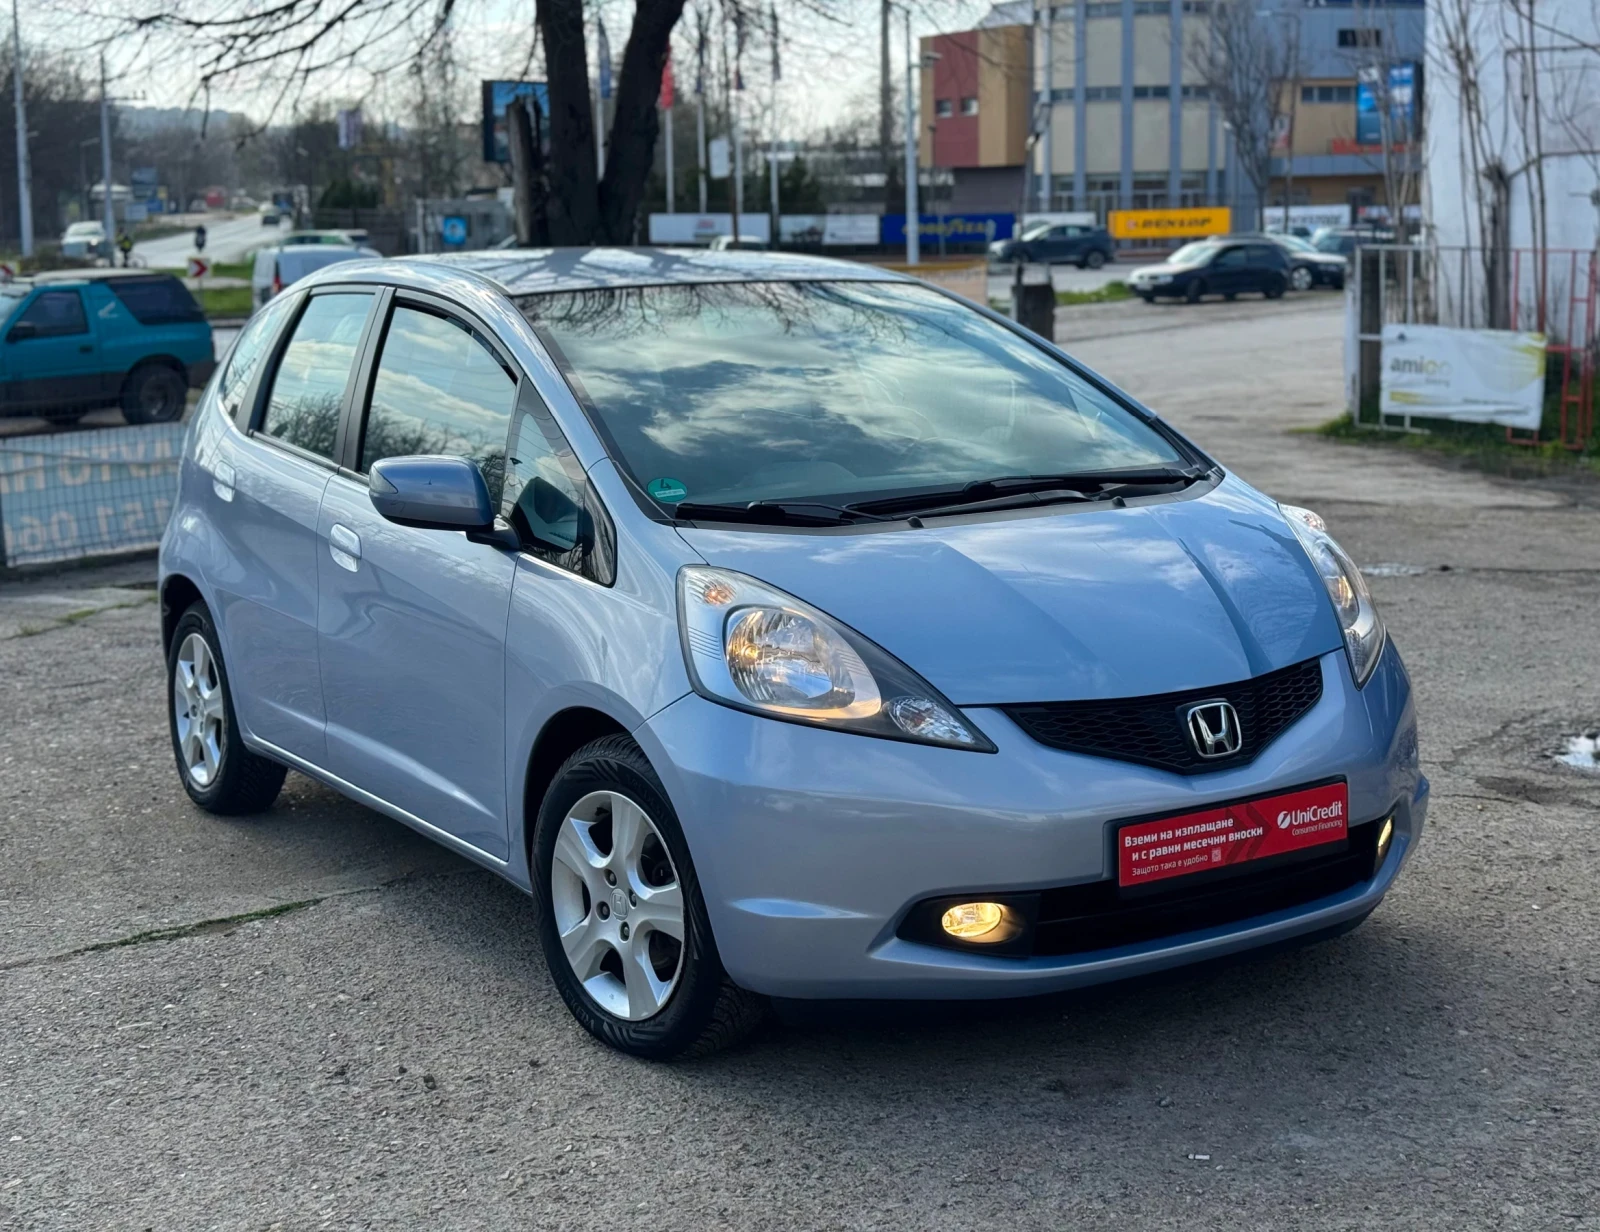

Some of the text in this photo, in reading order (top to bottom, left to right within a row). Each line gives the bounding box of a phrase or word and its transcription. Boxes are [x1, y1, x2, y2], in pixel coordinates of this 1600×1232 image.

[902, 218, 994, 237] ODYEA
[1292, 800, 1343, 825] UniCredit
[1124, 818, 1234, 847] Вземи на изплащане
[1292, 820, 1343, 836] Consumer Financing
[1132, 827, 1263, 861] и с равни месечни вноски
[1132, 865, 1159, 876] Защото
[1160, 860, 1177, 870] така
[1183, 854, 1208, 867] удобно
